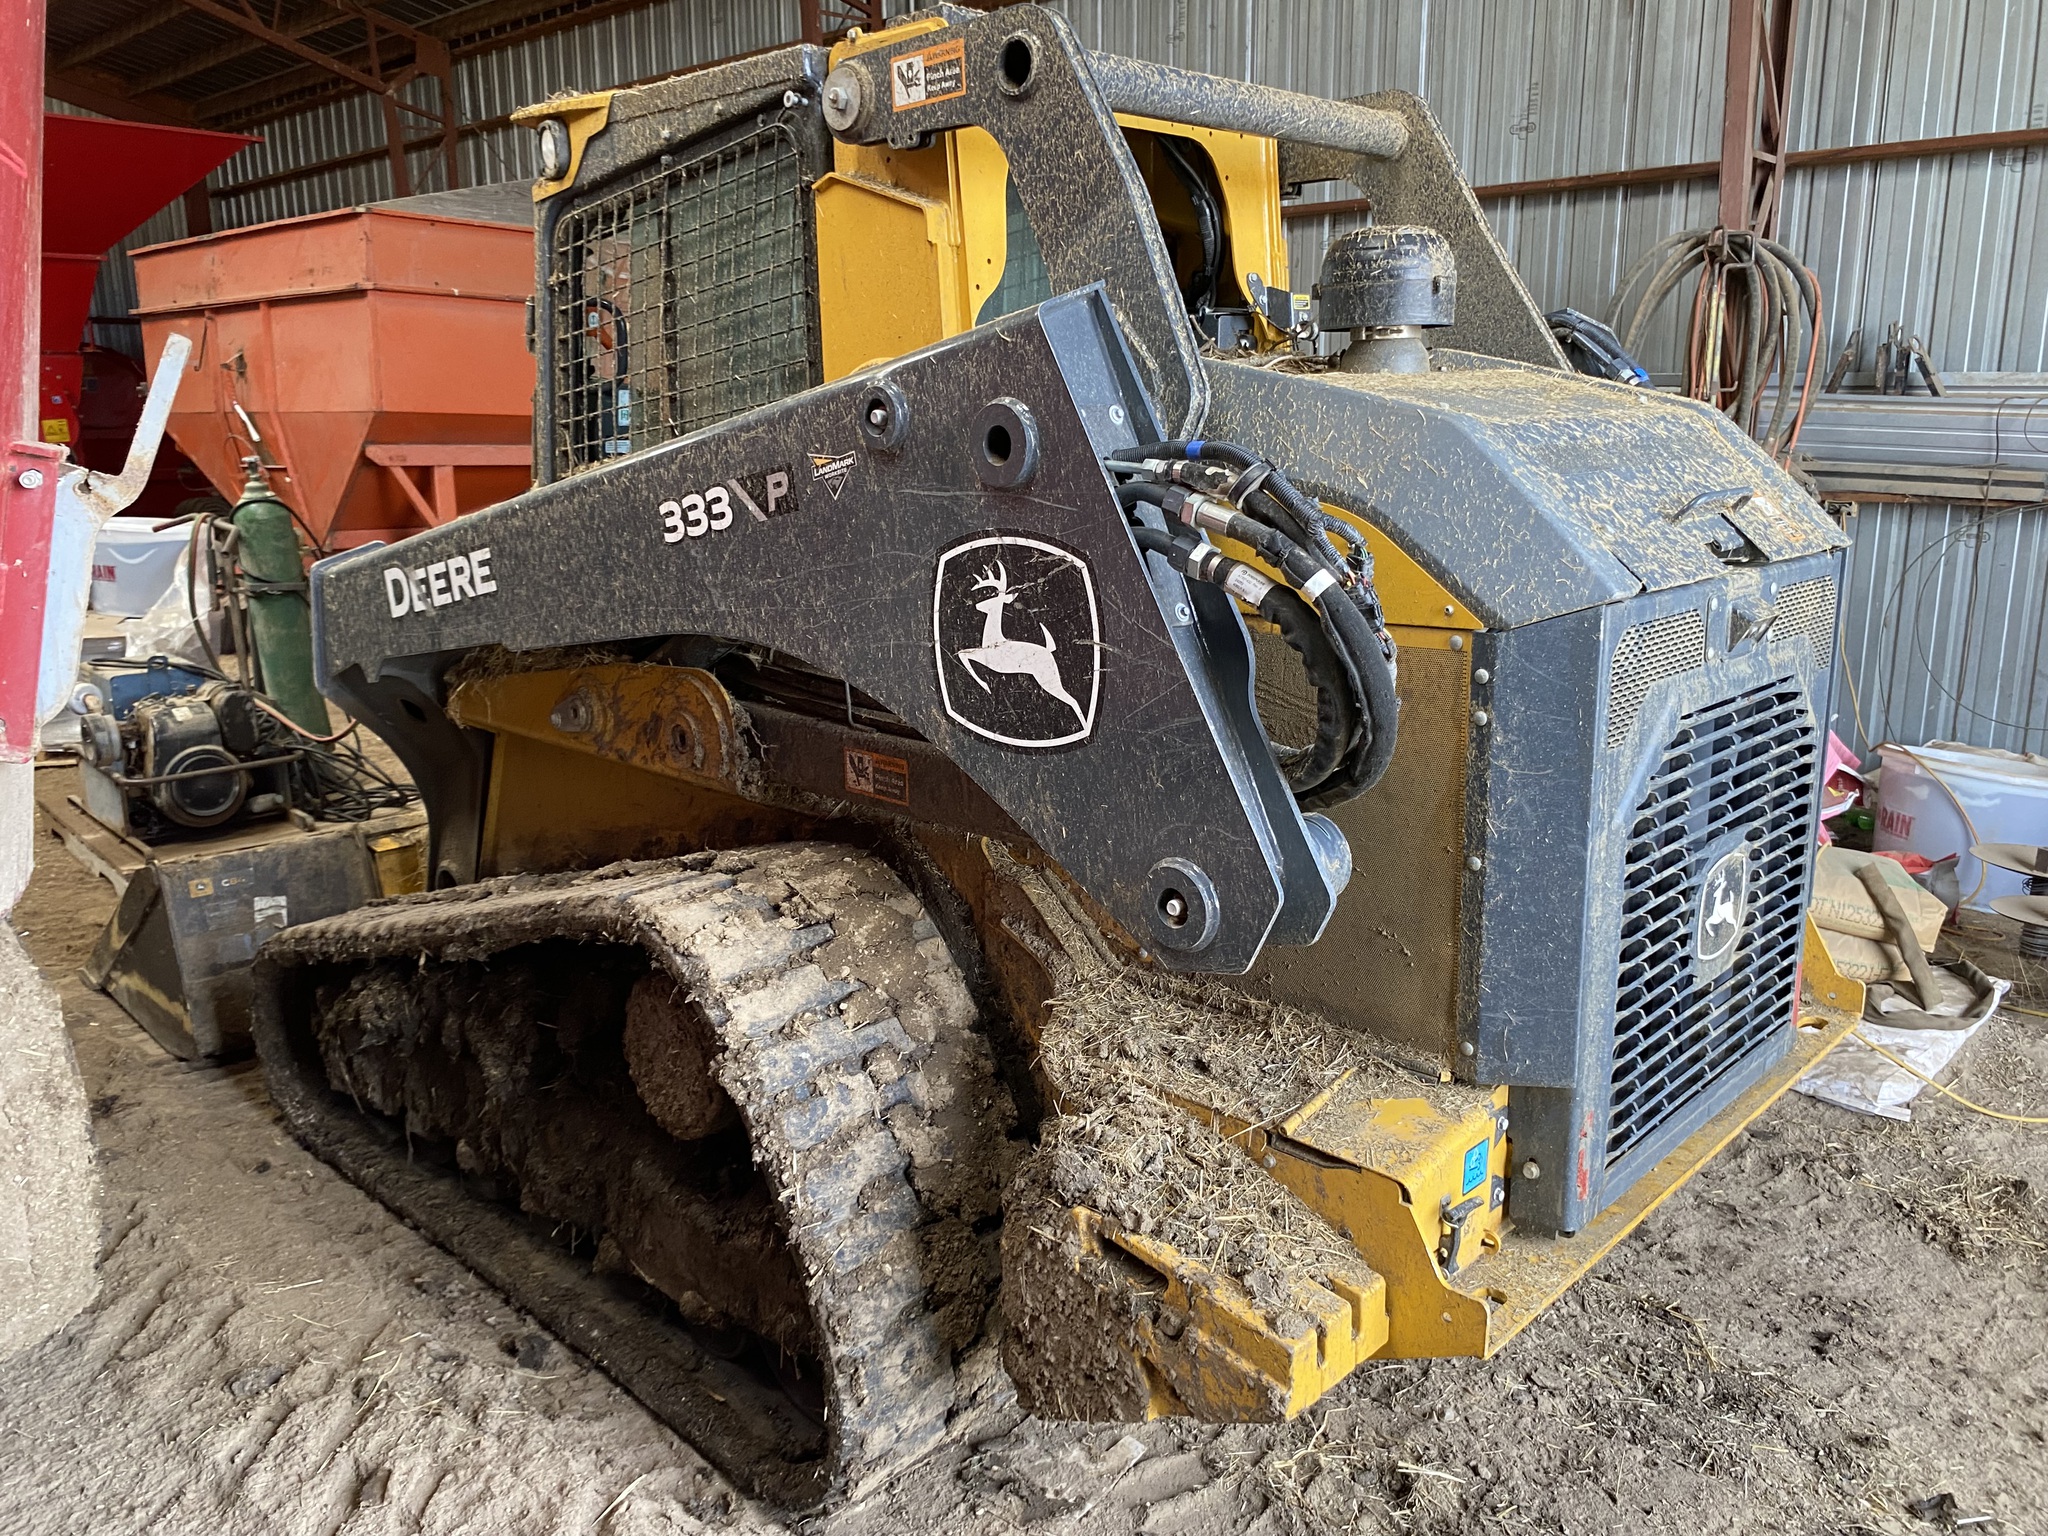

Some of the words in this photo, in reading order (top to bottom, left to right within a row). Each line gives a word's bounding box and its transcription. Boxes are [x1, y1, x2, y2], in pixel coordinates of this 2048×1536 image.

[813, 456, 855, 477] LANDMARK
[658, 486, 734, 544] 333
[383, 547, 498, 619] DEERE
[1878, 806, 1912, 837] RAIN
